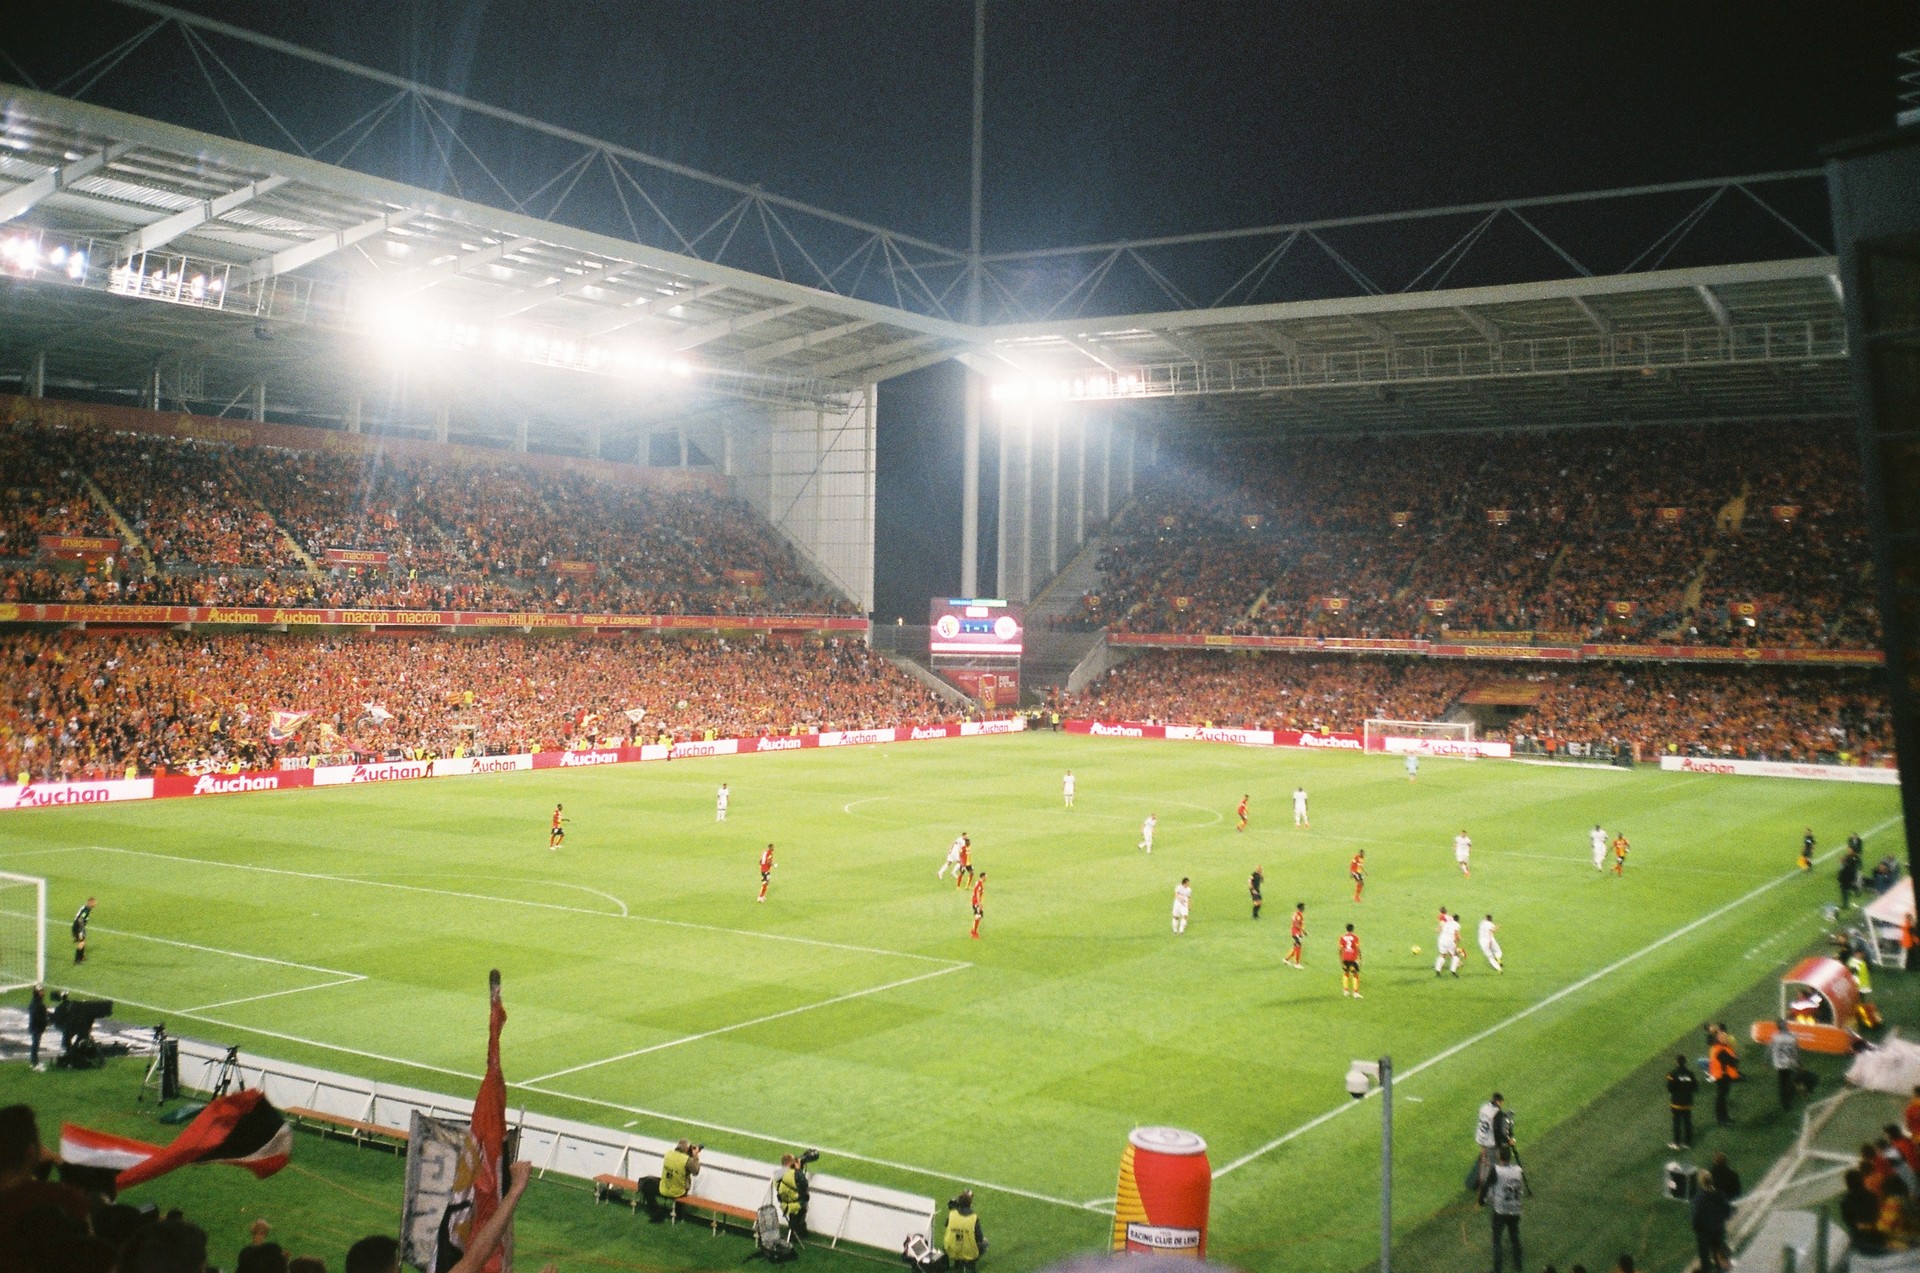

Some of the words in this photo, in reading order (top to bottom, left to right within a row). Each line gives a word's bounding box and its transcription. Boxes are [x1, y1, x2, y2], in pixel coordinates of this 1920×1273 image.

[73, 605, 113, 615] FRANCE
[116, 606, 162, 616] CONFORT
[207, 607, 258, 623] Auchan
[273, 608, 321, 624] Auchan
[342, 610, 389, 623] macron
[396, 610, 441, 624] macron
[965, 624, 970, 632] 1
[983, 624, 988, 632] 1
[911, 726, 947, 740] Auchan
[978, 719, 1009, 734] Auchan
[1090, 722, 1143, 737] Auchan
[839, 731, 877, 745] Auchan
[1194, 728, 1246, 743] Auchan
[1299, 733, 1360, 749] Auchan
[757, 736, 801, 751] Auchan
[471, 758, 516, 773] Auchan
[559, 751, 618, 766] Auchan
[1681, 758, 1735, 774] Auchan
[351, 765, 421, 783] Auchan
[193, 775, 278, 795] Auchan
[15, 785, 109, 806] Auchan
[1130, 1230, 1153, 1243] RACING
[1154, 1236, 1173, 1245] CLUB
